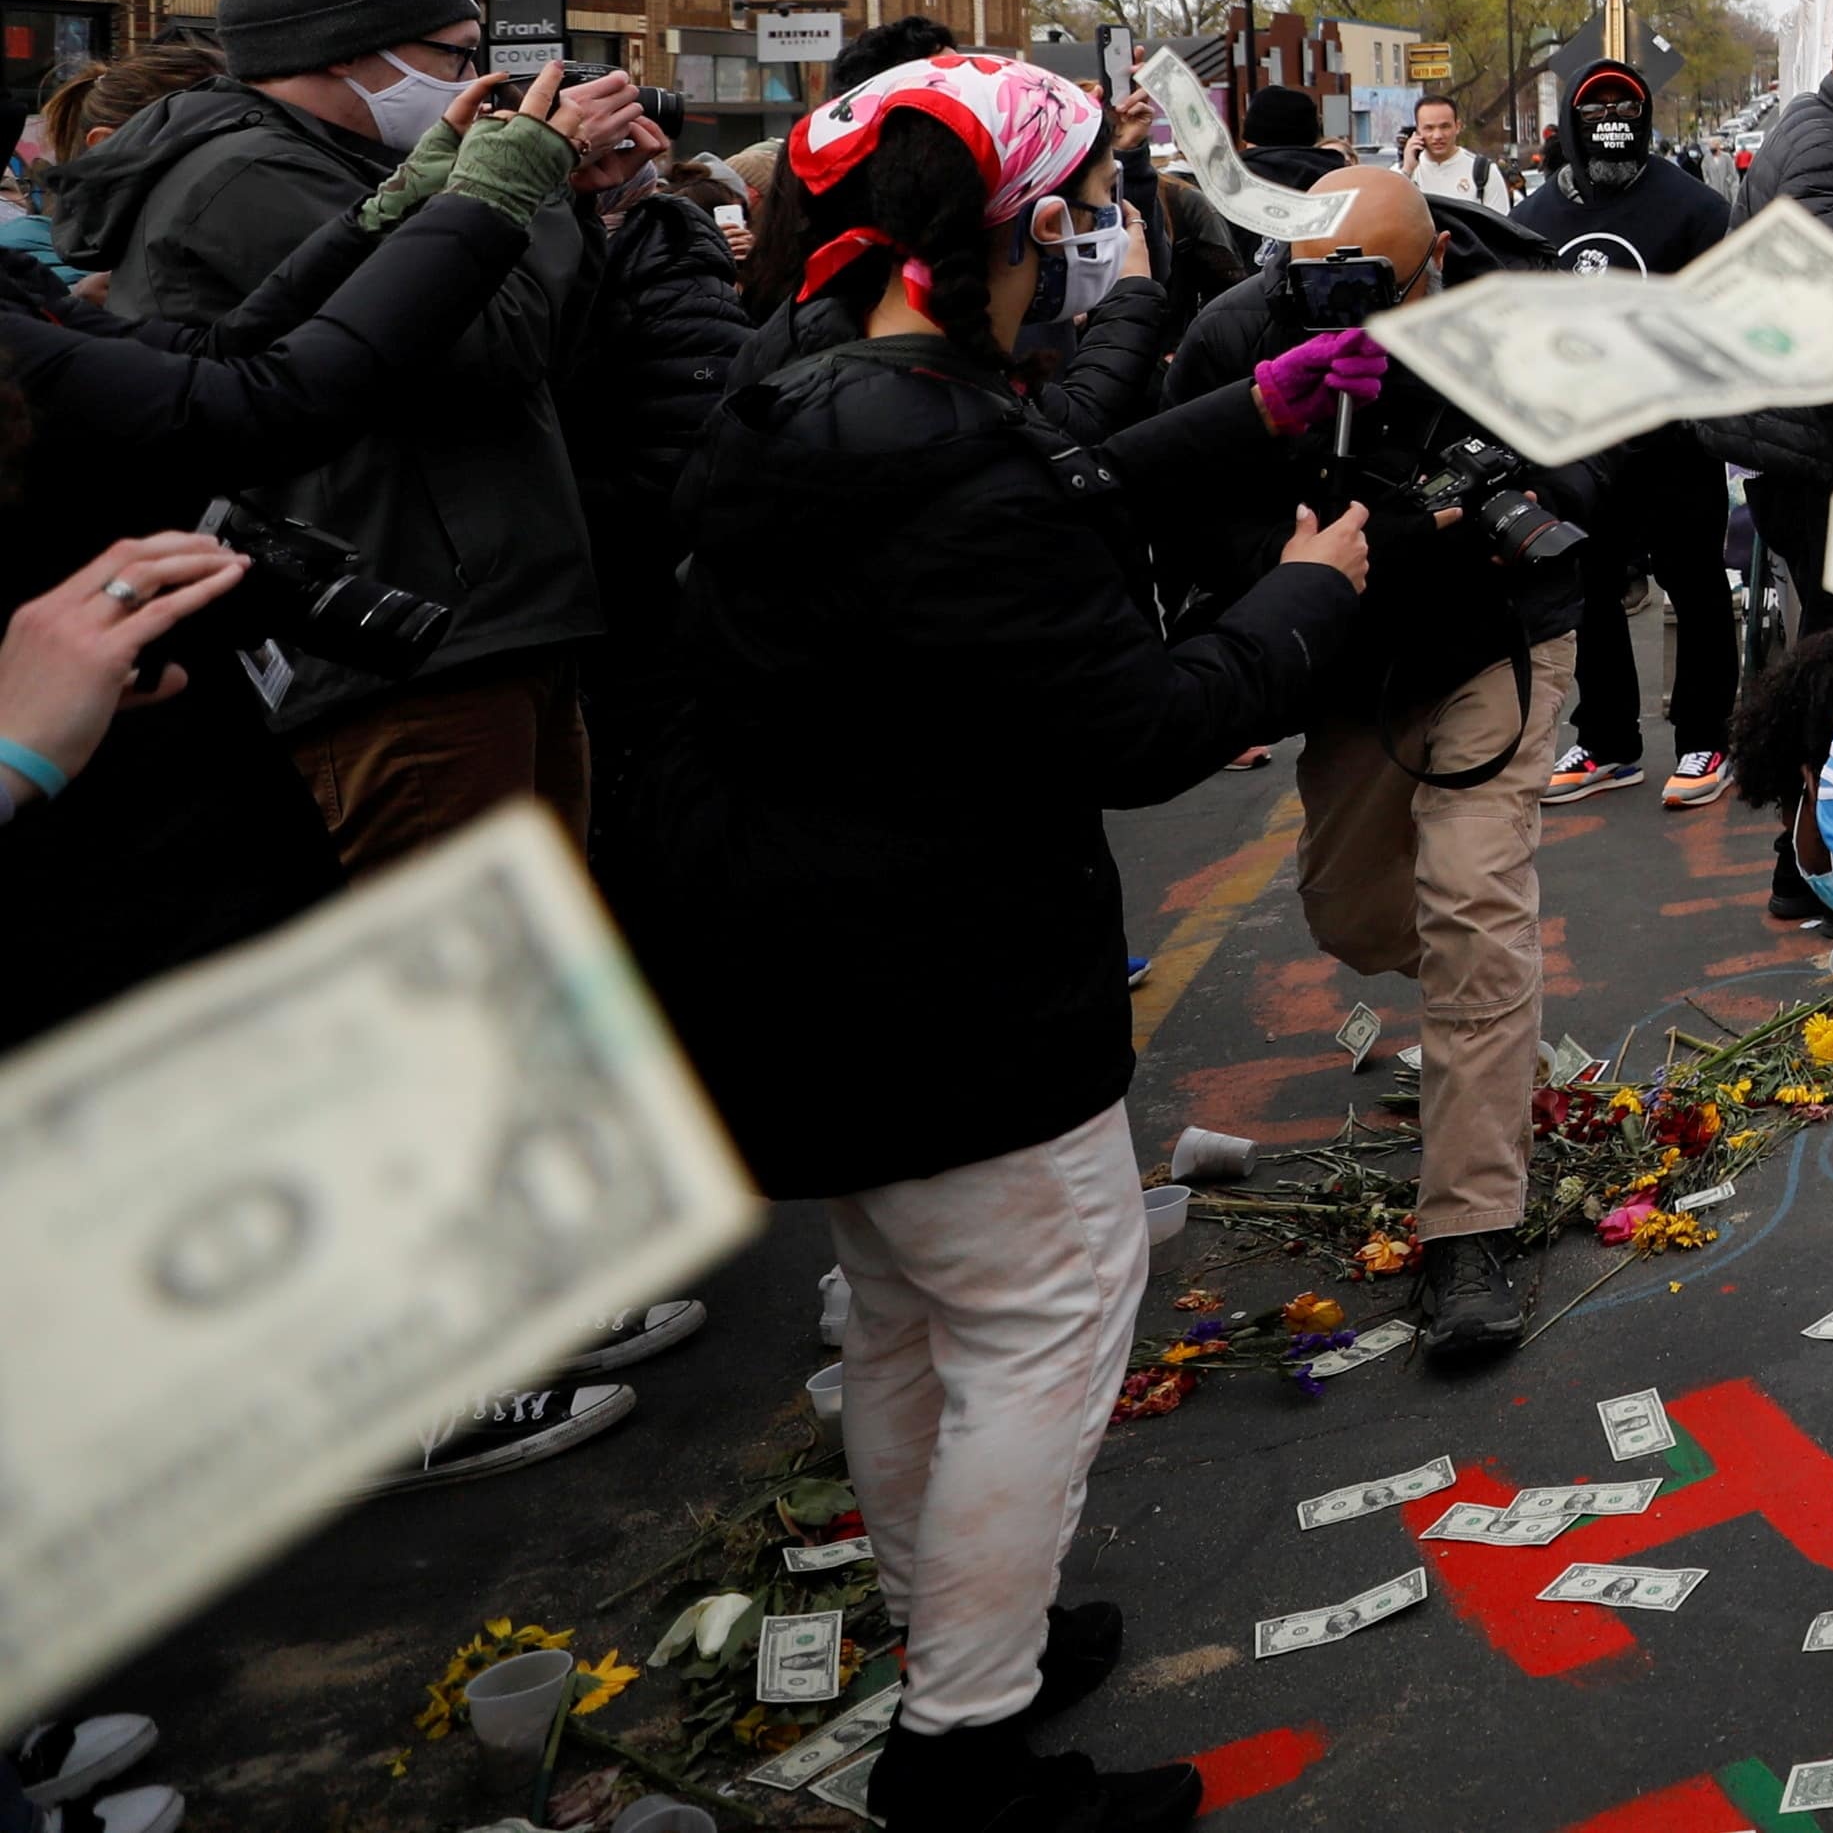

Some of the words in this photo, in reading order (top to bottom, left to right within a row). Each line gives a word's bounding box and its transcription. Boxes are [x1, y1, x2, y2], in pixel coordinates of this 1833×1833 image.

[495, 18, 557, 36] Frank
[494, 47, 558, 64] covet
[1596, 122, 1631, 133] AGAPE
[1603, 141, 1625, 150] VOTE
